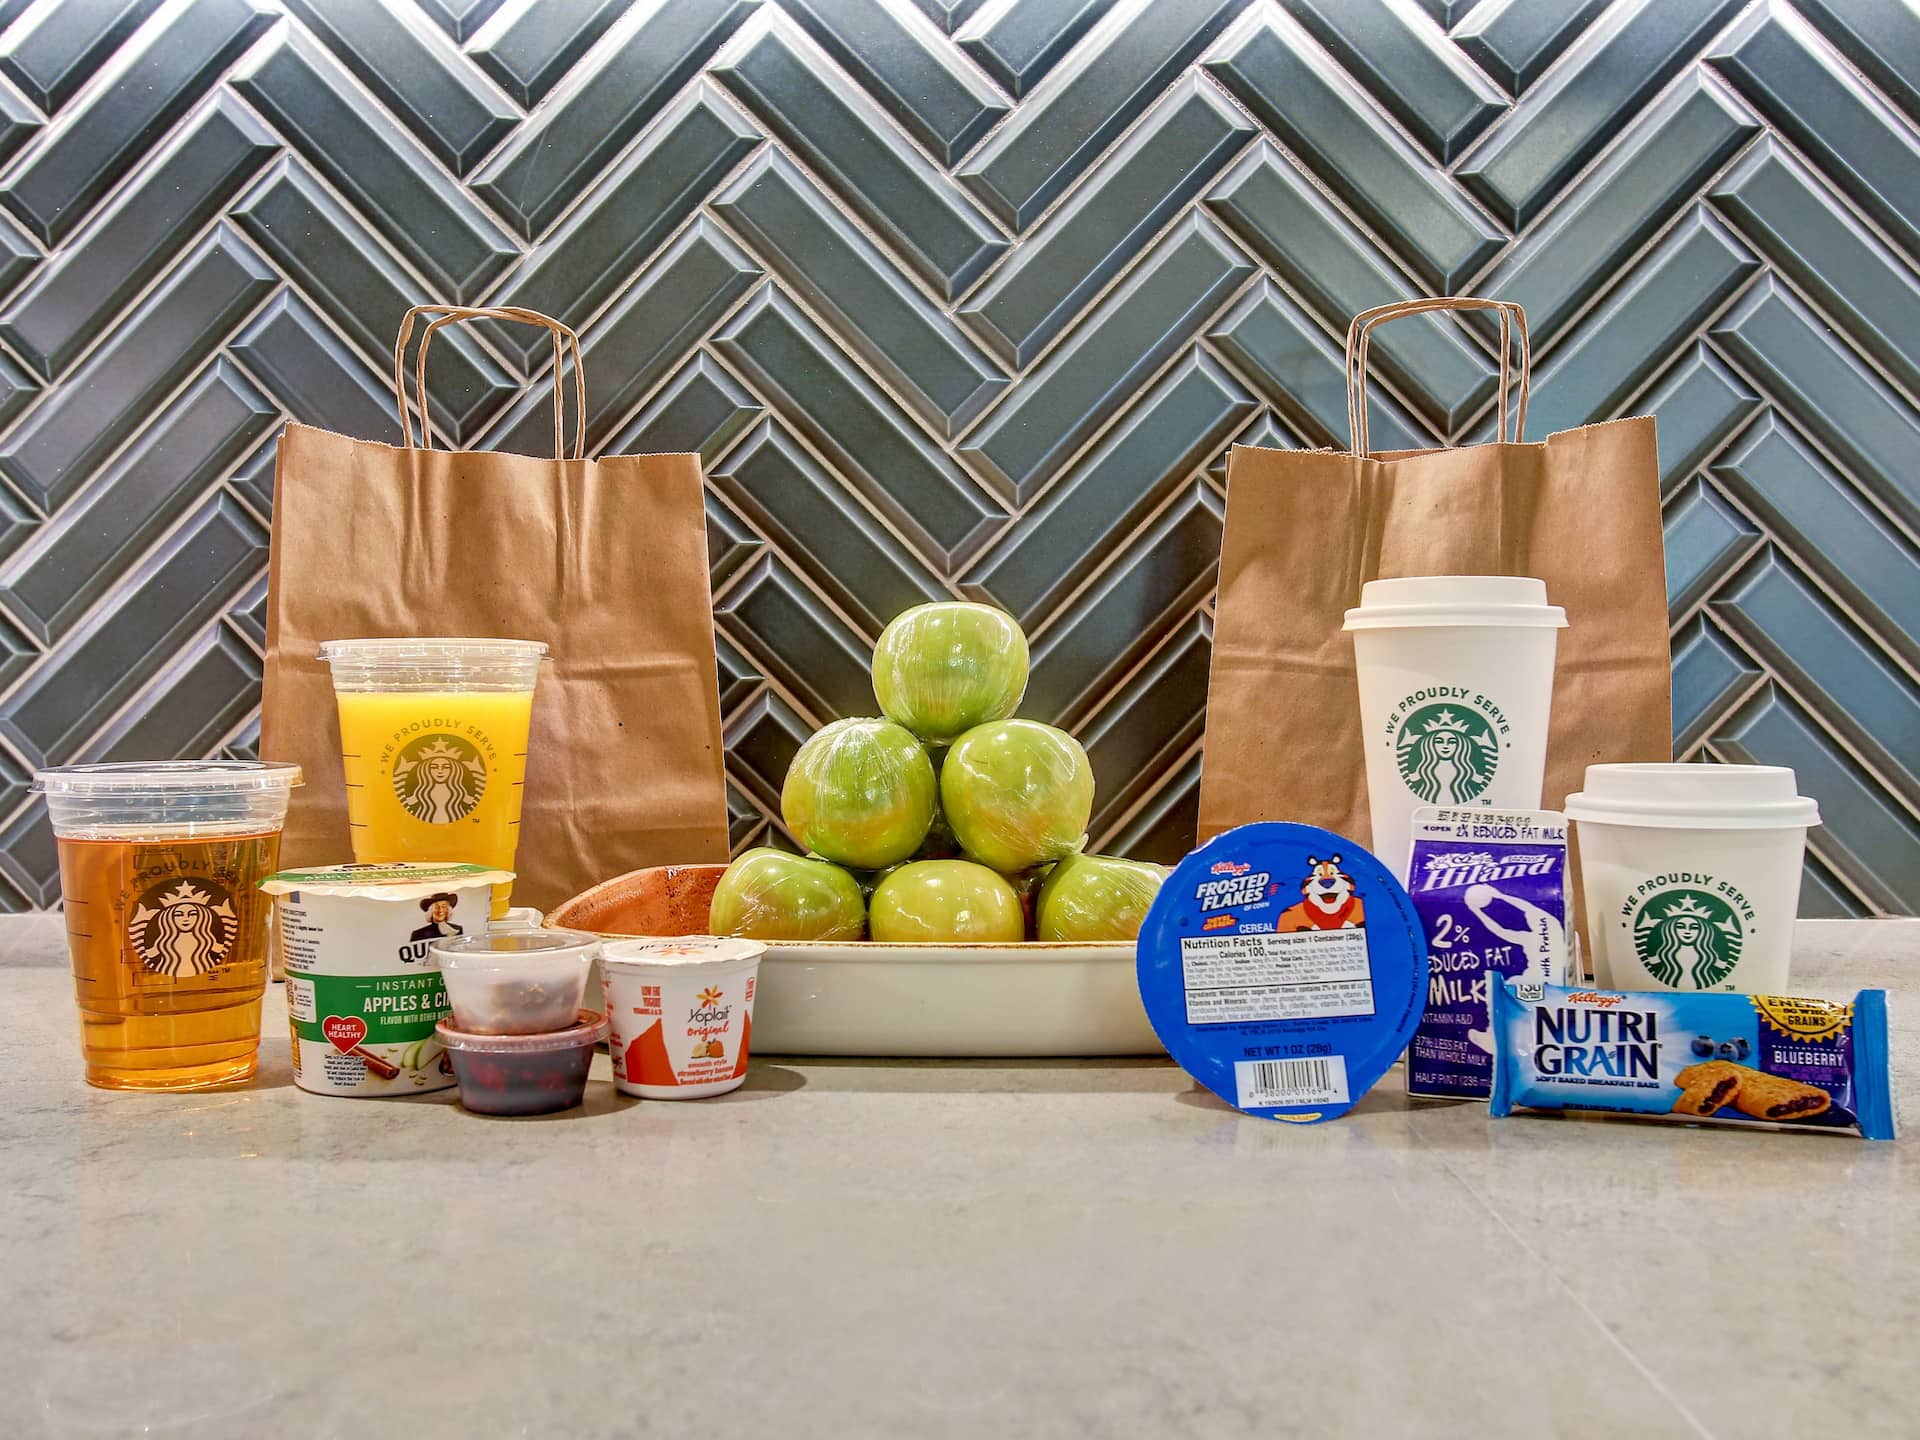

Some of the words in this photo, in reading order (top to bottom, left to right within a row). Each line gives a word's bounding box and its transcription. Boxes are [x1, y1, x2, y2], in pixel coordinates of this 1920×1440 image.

[1386, 713, 1400, 734] WE
[1398, 686, 1470, 712] PROUDLY
[1474, 695, 1510, 735] SERVE
[380, 744, 395, 763] WE
[394, 718, 462, 743] PROUDLY
[465, 725, 497, 761] SERVE
[1472, 825, 1518, 839] REDUCED
[1521, 827, 1539, 839] FAT
[1542, 827, 1565, 840] MILK
[1421, 857, 1556, 891] Hiland
[1196, 872, 1270, 899] FROSTED
[1621, 895, 1638, 916] WE
[1636, 872, 1713, 896] PROUDLY
[1717, 881, 1755, 920] SERVE
[1201, 888, 1265, 912] FLAKES
[1239, 922, 1277, 934] CEREAL
[1431, 913, 1471, 948] 2%
[1184, 938, 1230, 949] Nutrition
[1233, 937, 1263, 947] Facts
[1219, 950, 1247, 959] Calories
[1484, 945, 1513, 967] FAT
[377, 977, 434, 992] INSTANT
[1429, 974, 1488, 1007] MILK
[363, 994, 417, 1013] APPLES
[422, 991, 432, 1009] &
[1567, 992, 1623, 1008] Kellogg's
[687, 1006, 731, 1026] Yoplait
[1535, 1006, 1657, 1045] NUTRI
[1788, 1015, 1827, 1027] GRAINS
[328, 1030, 363, 1039] HEALTHY
[331, 1023, 357, 1032] HEART
[1533, 1042, 1658, 1080] GRAIN
[1773, 1050, 1845, 1067] BLUEBERRY
[1535, 1075, 1558, 1084] SOFT
[1559, 1077, 1587, 1086] BAKED
[1588, 1078, 1637, 1087] BREAKFAST
[1637, 1080, 1660, 1089] BARS
